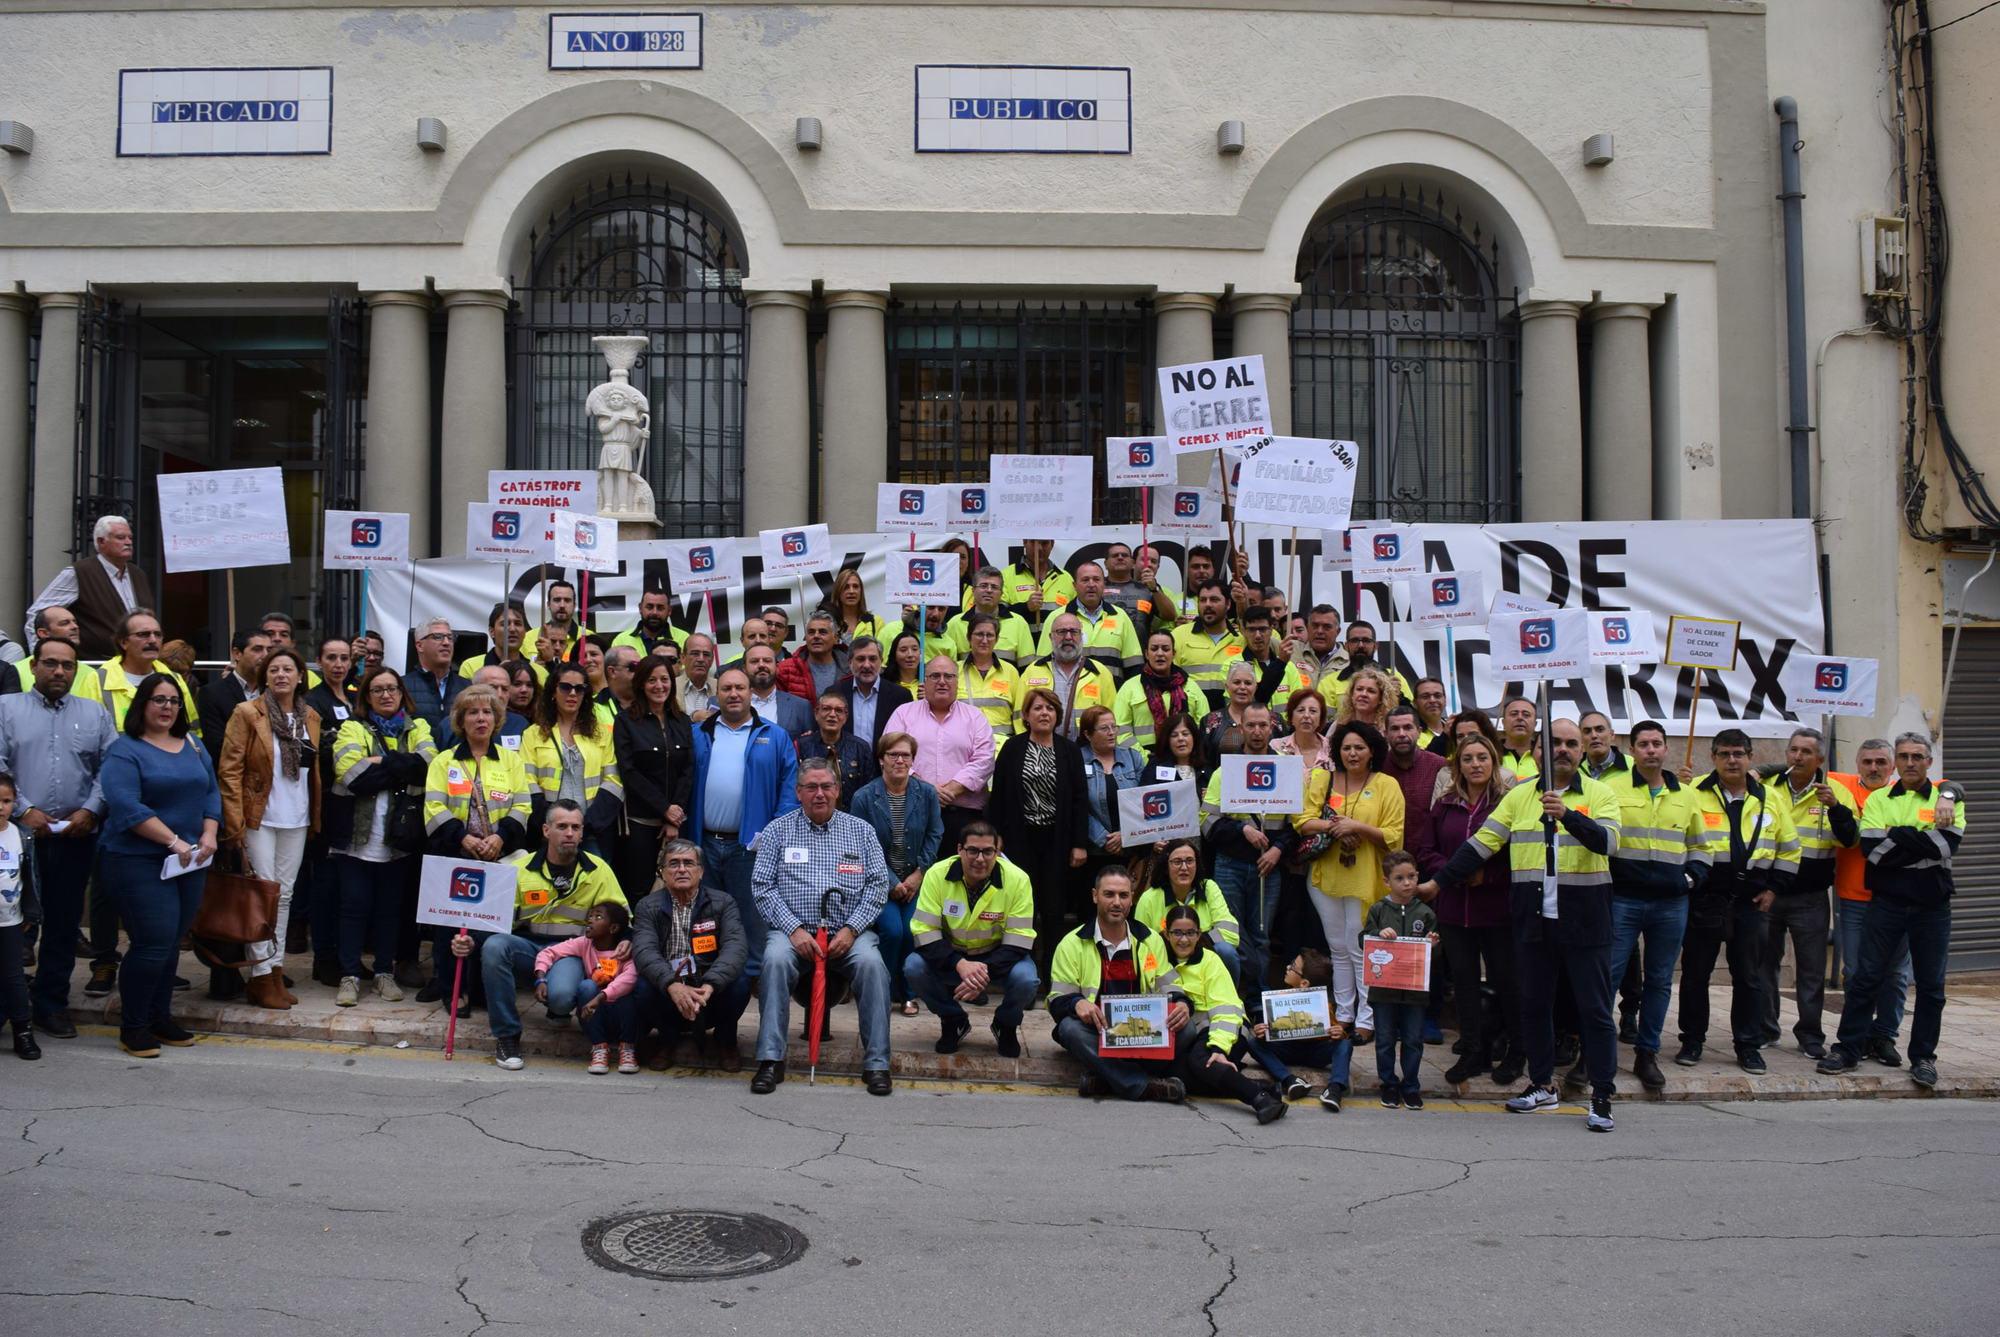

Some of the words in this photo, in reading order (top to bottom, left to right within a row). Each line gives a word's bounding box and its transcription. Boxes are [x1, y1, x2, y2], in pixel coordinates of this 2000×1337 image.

[643, 32, 683, 51] 1928
[152, 101, 298, 122] MERCADO
[951, 99, 1095, 119] PUBLICO
[1171, 368, 1216, 394] NO
[1225, 364, 1255, 389] AL
[186, 479, 218, 495] NO
[500, 478, 581, 492] CATÁSTROFE
[1242, 491, 1351, 515] AFECTADAS
[1500, 539, 1631, 613] DE
[1703, 629, 1726, 637] CIERRE
[1696, 639, 1719, 648] CEMEX
[1689, 650, 1713, 658] GADOR
[1512, 663, 1536, 671] CIERRE
[1114, 1005, 1123, 1013] NO
[1131, 1004, 1151, 1012] CIERRE
[1275, 1000, 1283, 1008] NO
[1284, 999, 1291, 1007] AL
